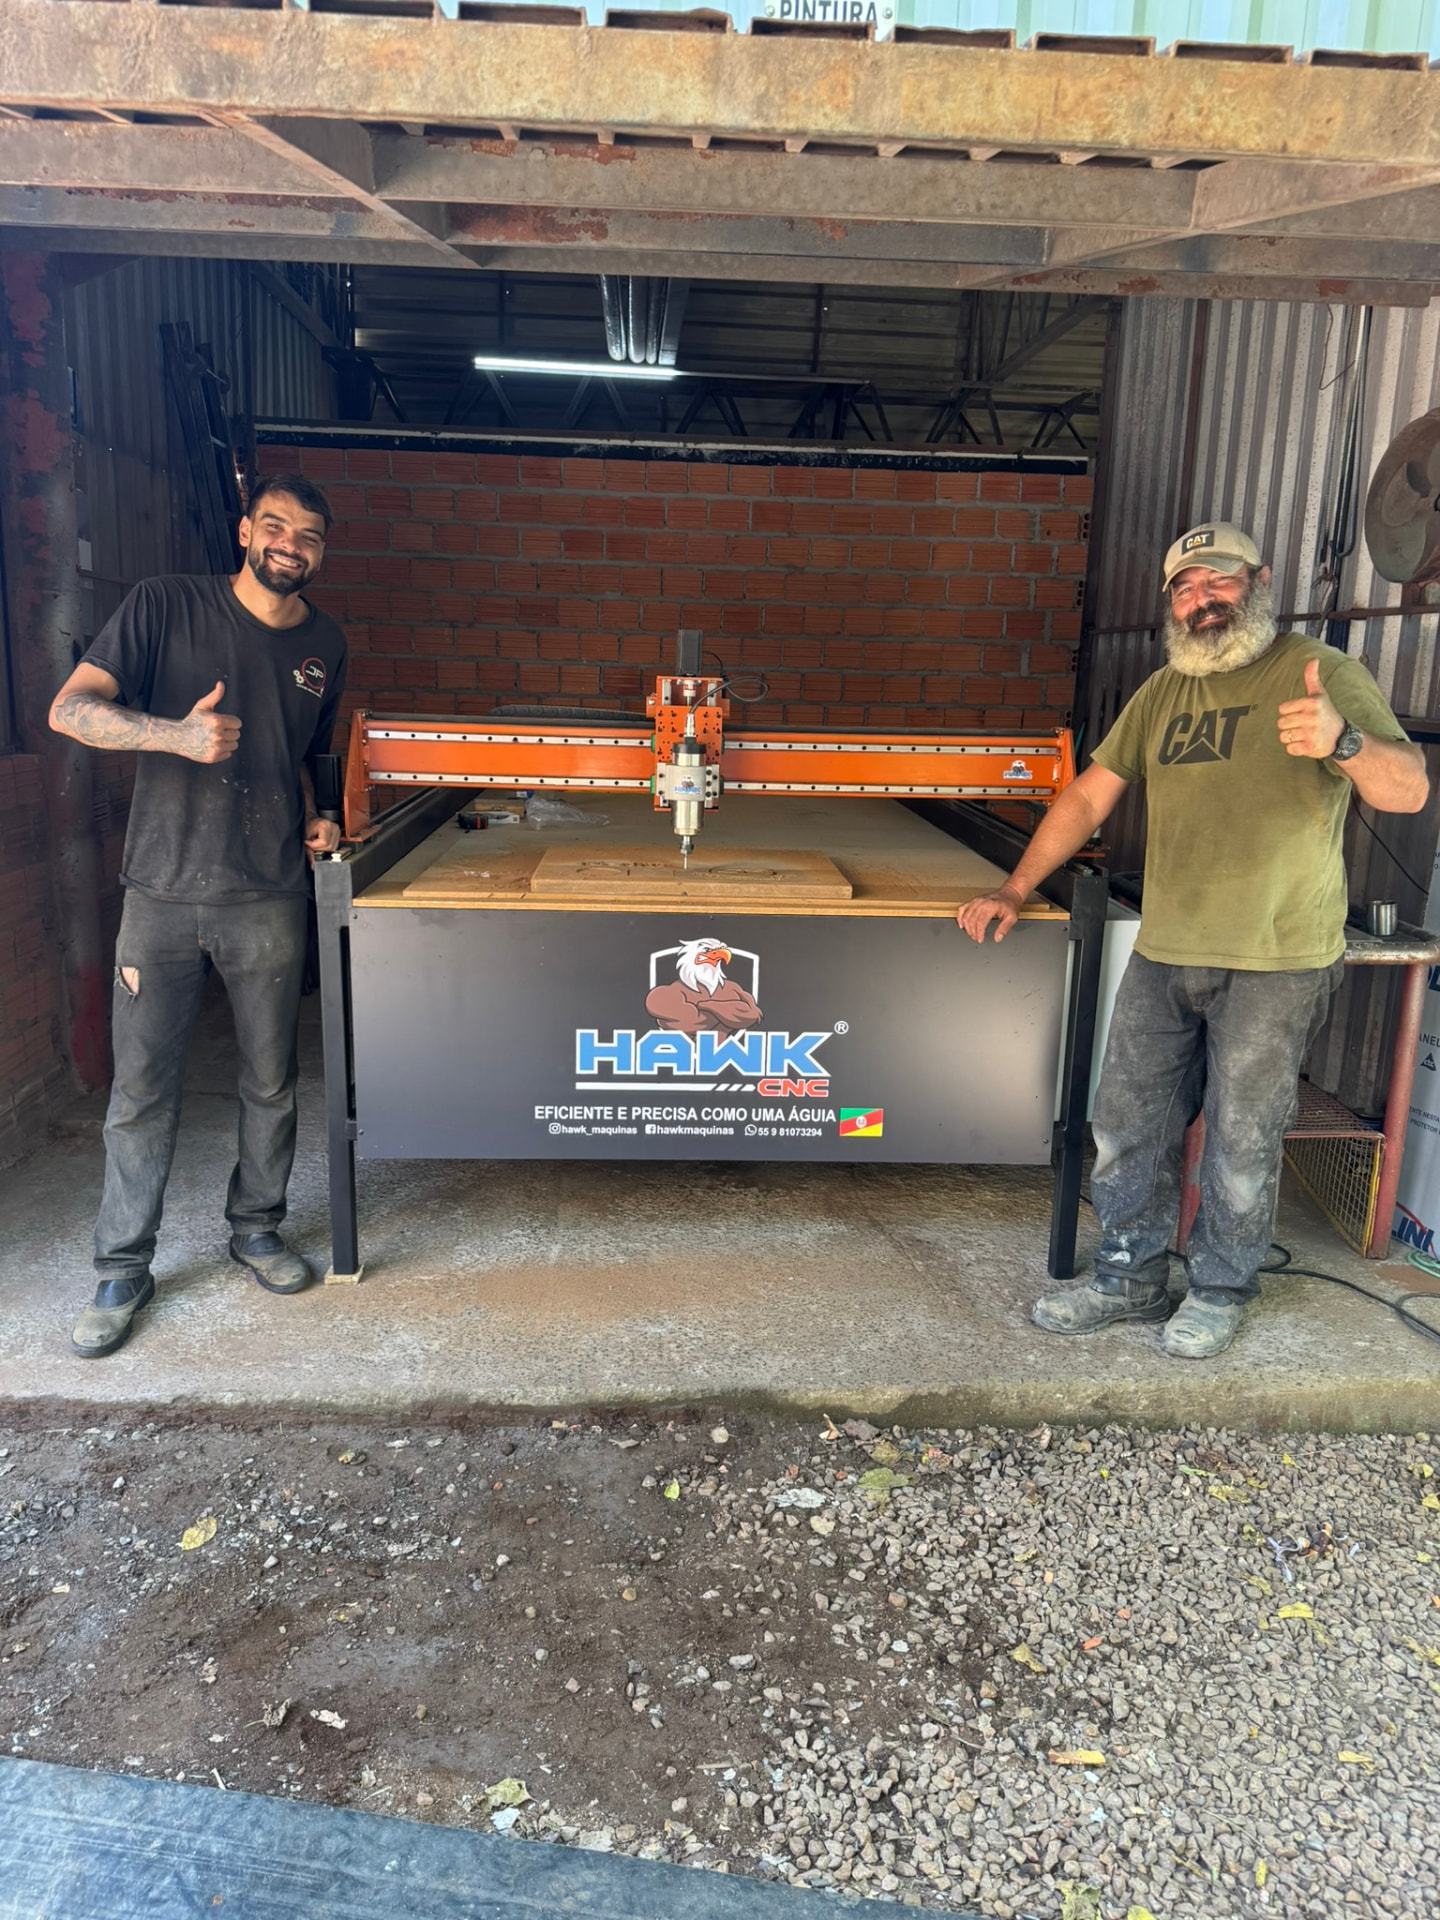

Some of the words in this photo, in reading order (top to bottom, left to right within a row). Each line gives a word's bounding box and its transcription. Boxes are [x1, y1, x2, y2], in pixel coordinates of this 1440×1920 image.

[780, 0, 878, 29] PINTURA
[1186, 533, 1209, 549] CAT
[1158, 705, 1251, 766] CAT
[576, 1029, 833, 1077] HAWK
[757, 1079, 829, 1097] CNC
[534, 1105, 614, 1120] EFICIENTE
[617, 1106, 628, 1120] E
[631, 1106, 698, 1121] PRECISA
[701, 1107, 748, 1122] COMO
[751, 1108, 786, 1122] UMA
[788, 1105, 837, 1122] ÁGUIA
[561, 1124, 638, 1137] hawk_maquinas
[656, 1125, 735, 1137] hawkmaquinas
[758, 1127, 769, 1136] 55
[770, 1128, 777, 1136] 9
[779, 1128, 822, 1137] 81073294
[1391, 1216, 1435, 1253] INI
